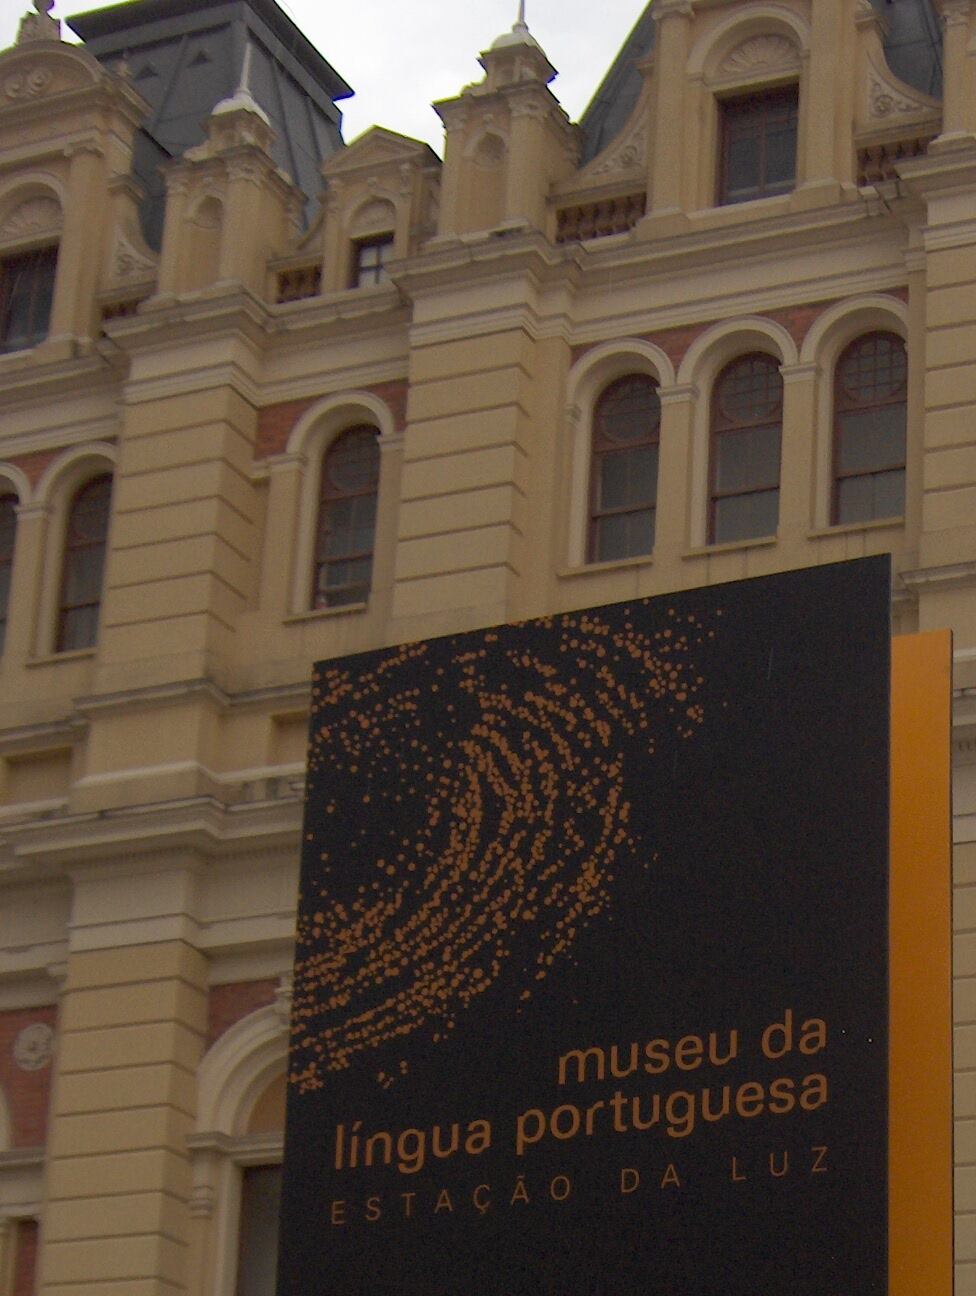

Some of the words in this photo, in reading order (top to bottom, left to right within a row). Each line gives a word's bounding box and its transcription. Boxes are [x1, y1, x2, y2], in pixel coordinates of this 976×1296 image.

[558, 1029, 738, 1085] museu
[760, 1008, 827, 1060] da
[334, 1119, 492, 1174] língua
[515, 1071, 829, 1156] portuguesa
[330, 1173, 572, 1225] ESTAÇÃO
[619, 1162, 681, 1195] DA
[730, 1145, 829, 1182] LUZ
